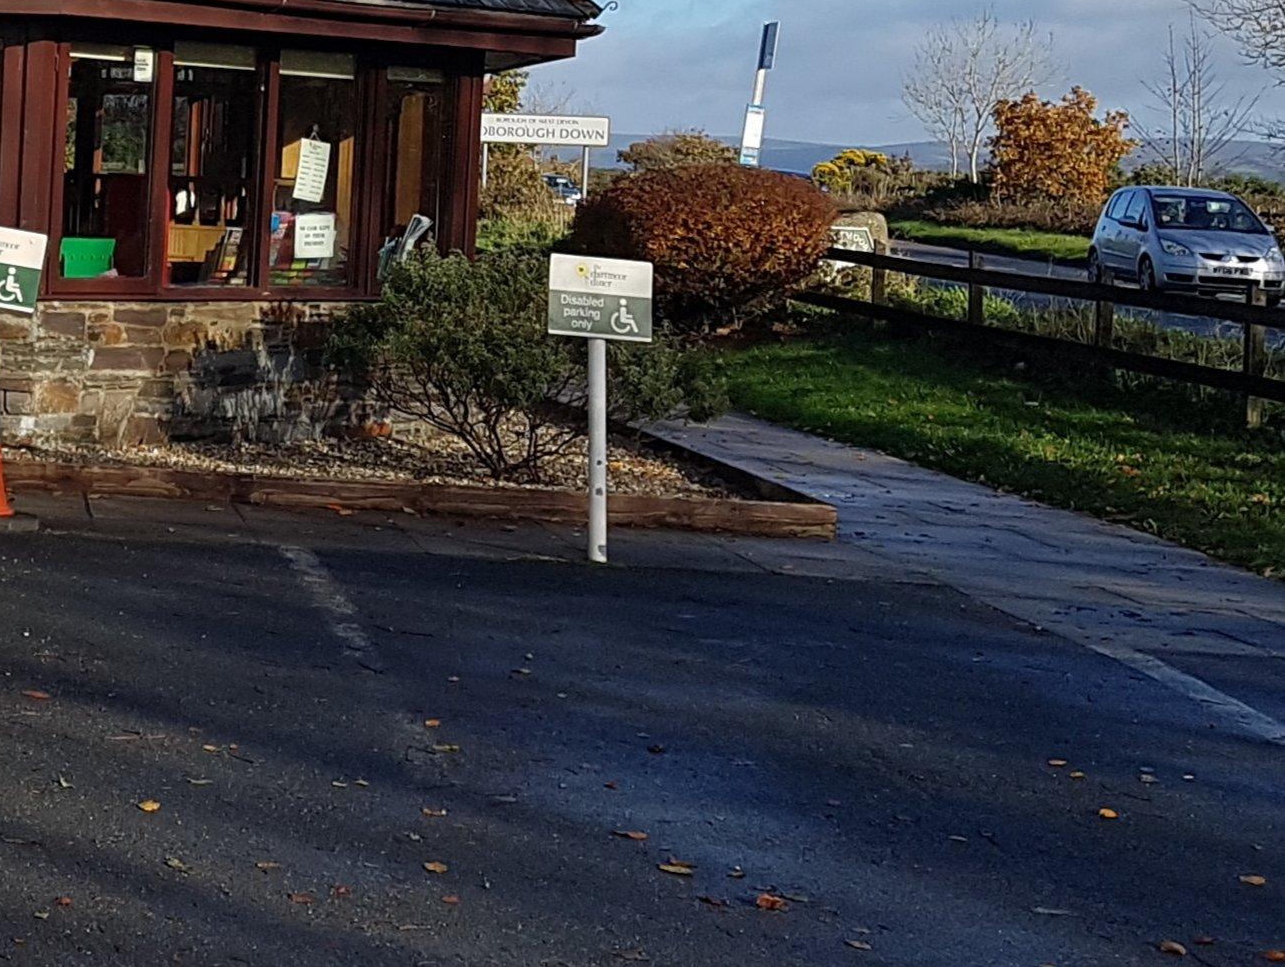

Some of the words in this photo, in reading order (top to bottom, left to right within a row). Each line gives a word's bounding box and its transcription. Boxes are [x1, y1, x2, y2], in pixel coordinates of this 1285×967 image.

[559, 128, 605, 140] DOWN
[560, 294, 604, 307] Disabled
[564, 307, 601, 321] parking
[571, 319, 593, 331] only
